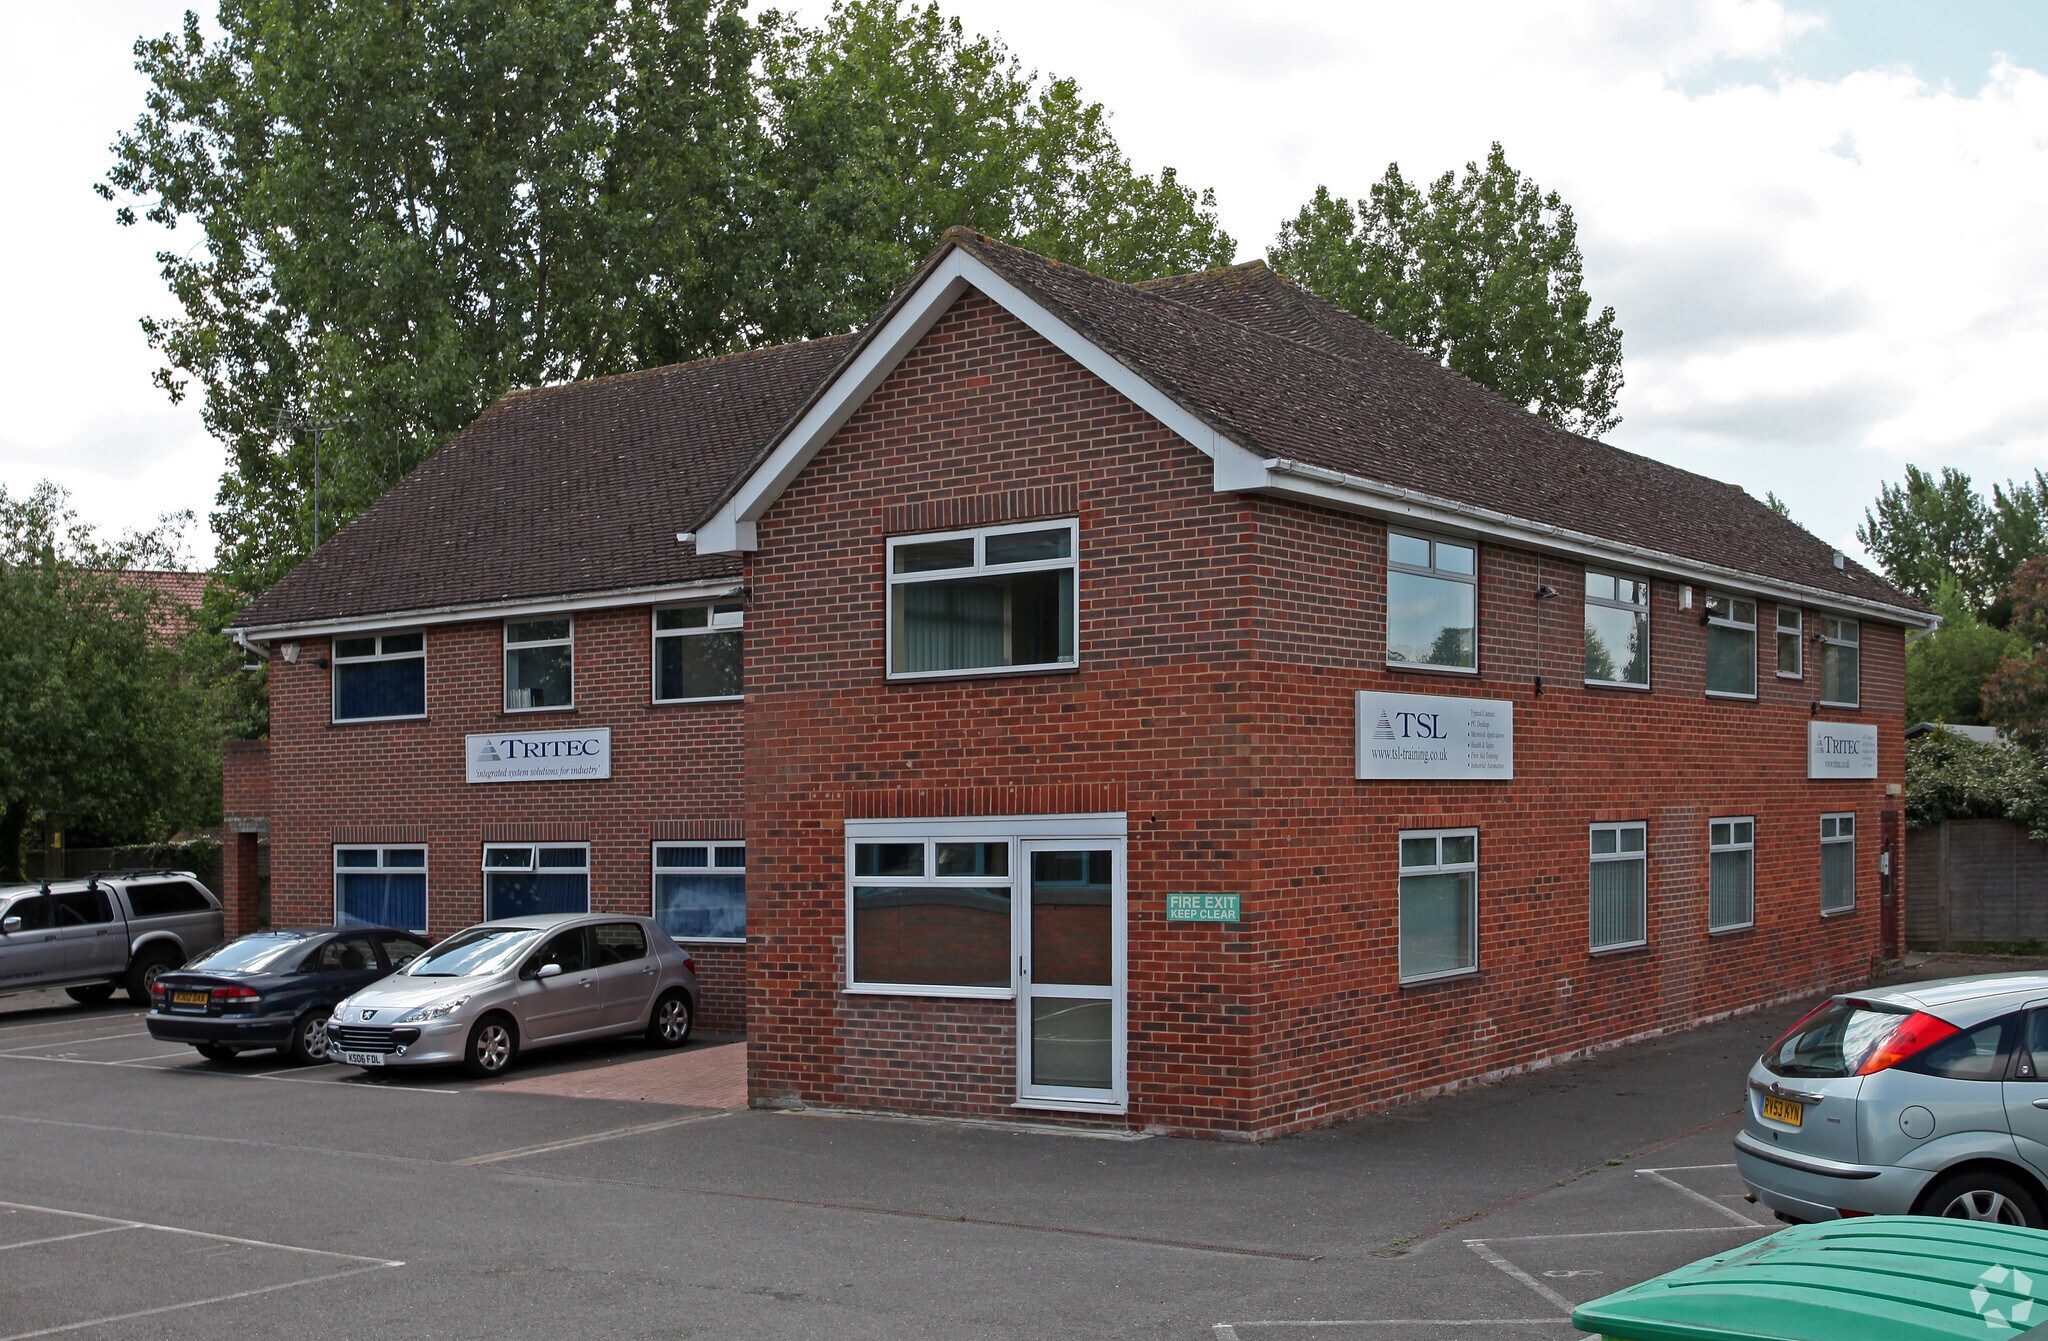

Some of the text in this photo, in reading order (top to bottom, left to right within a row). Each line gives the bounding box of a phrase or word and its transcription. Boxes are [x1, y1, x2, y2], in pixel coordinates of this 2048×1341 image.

[1395, 712, 1448, 739] TSL
[1371, 746, 1448, 764] www.tsl-training.co.uk
[508, 769, 530, 778] system
[529, 767, 559, 777] solutions
[559, 765, 570, 777] for
[1170, 896, 1236, 909] FIRE EXIT
[1171, 909, 1236, 919] KEEP CLEAR
[366, 1054, 381, 1064] FDL
[1763, 1097, 1800, 1121] RV53 KYN
